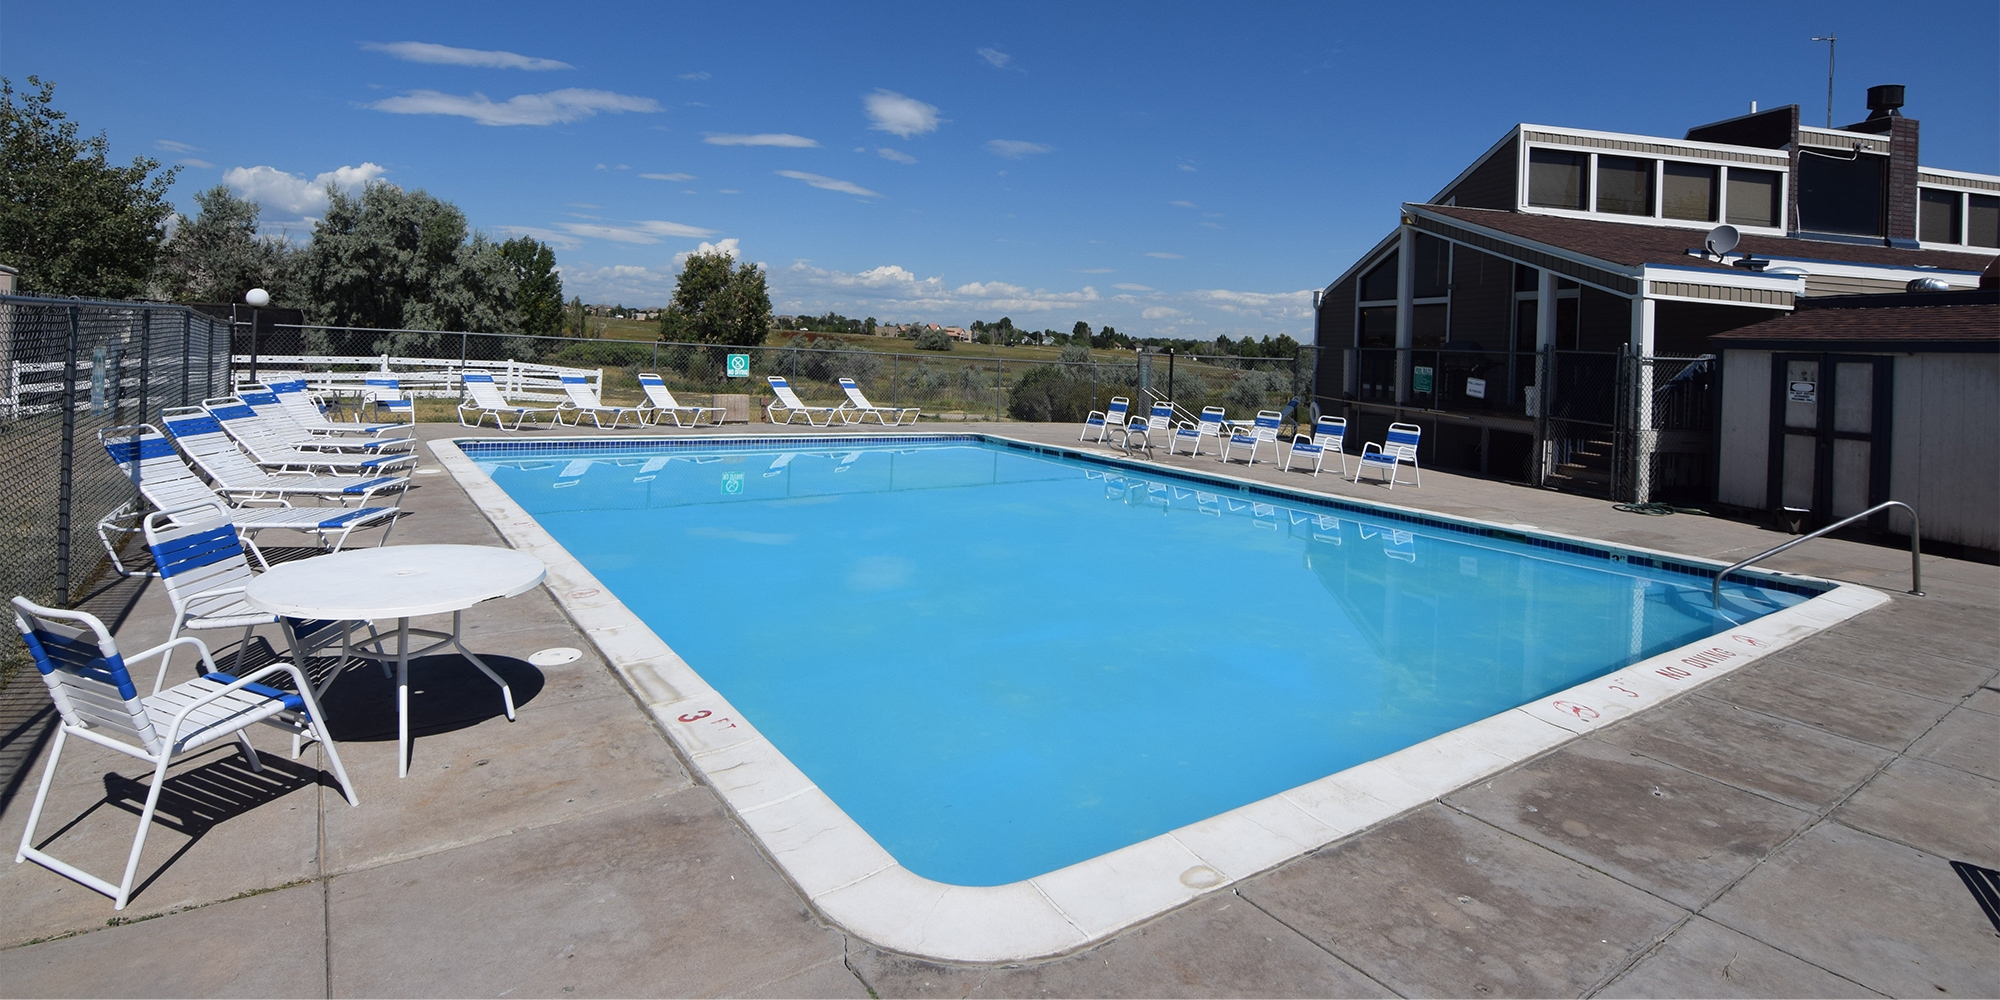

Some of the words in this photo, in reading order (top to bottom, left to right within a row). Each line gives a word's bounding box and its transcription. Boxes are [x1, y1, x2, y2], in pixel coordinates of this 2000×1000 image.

[1656, 666, 1691, 681] NO
[1681, 647, 1736, 669] DIVING
[678, 709, 712, 723] 3
